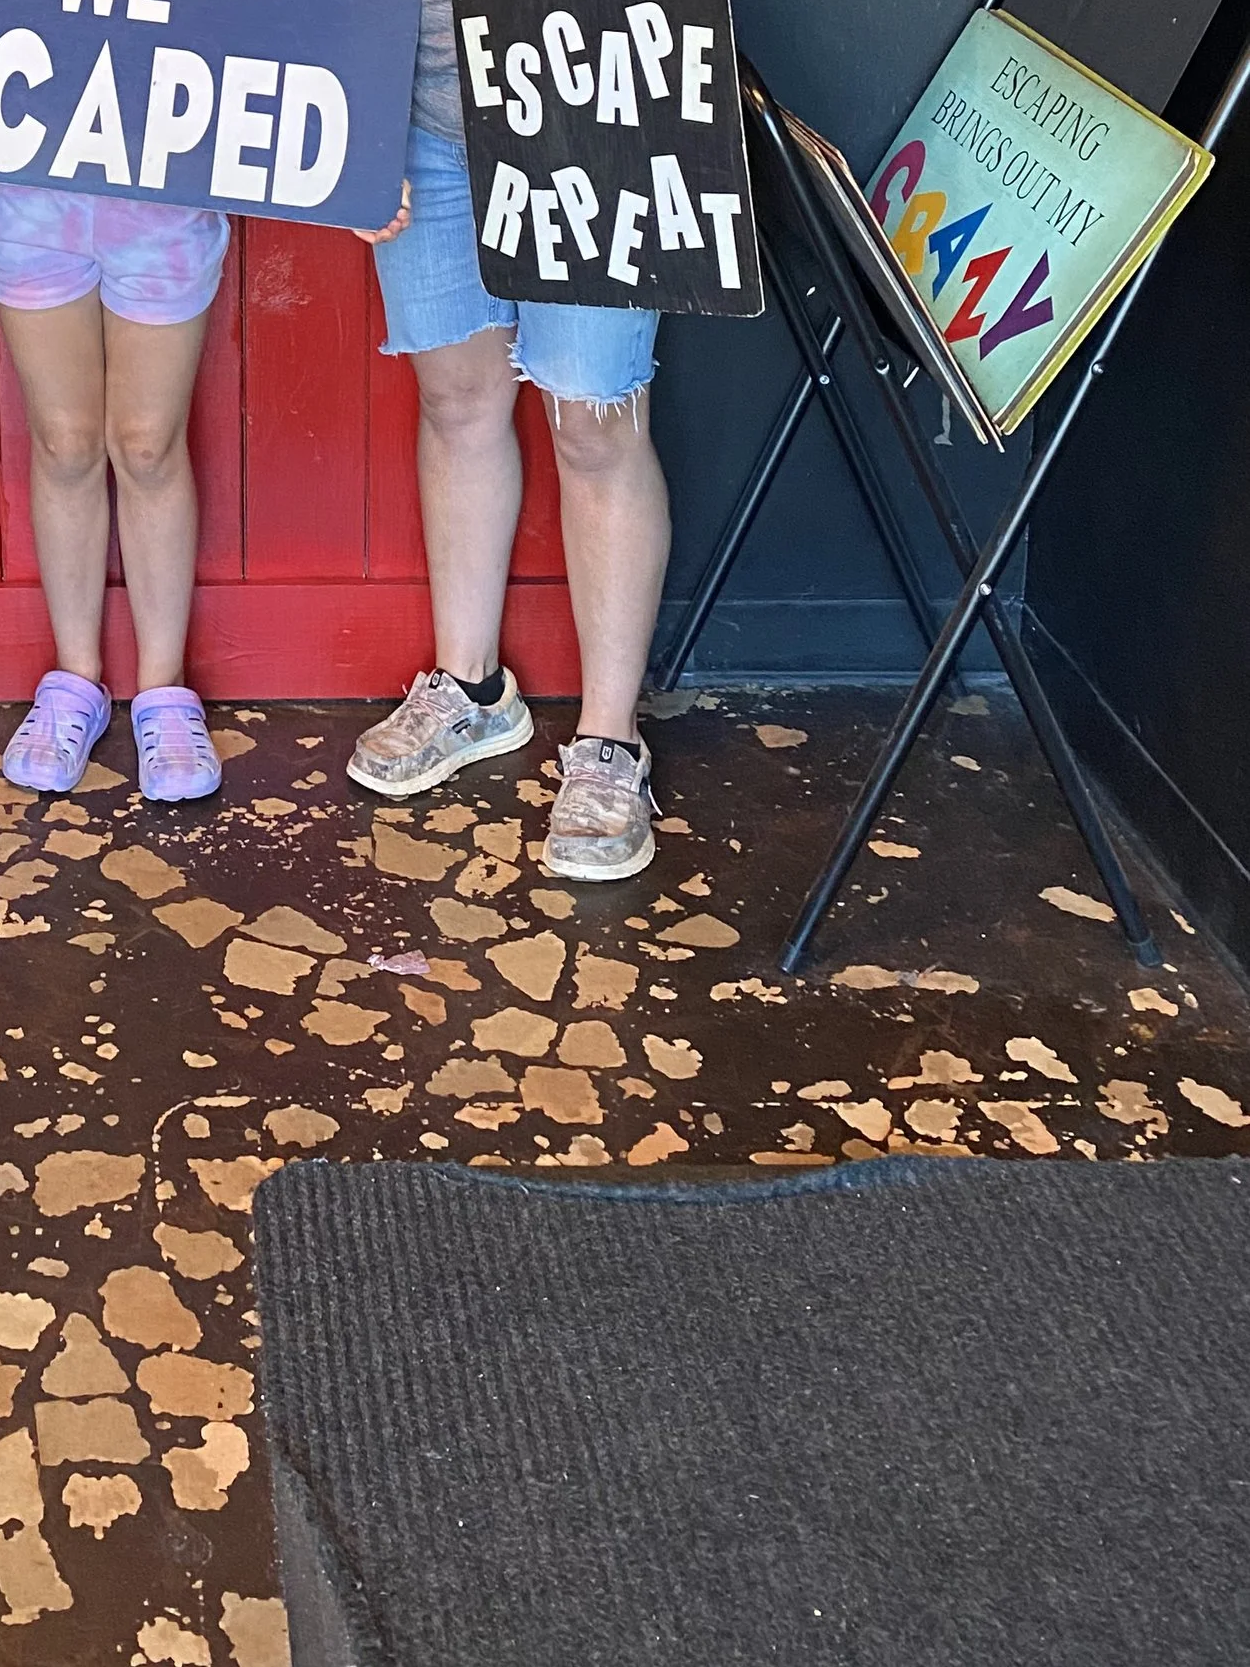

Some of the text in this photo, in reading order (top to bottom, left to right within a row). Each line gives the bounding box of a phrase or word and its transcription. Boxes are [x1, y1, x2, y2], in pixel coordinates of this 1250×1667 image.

[461, 1, 714, 136] ESCAPE
[990, 56, 1111, 162] ESCAPING
[480, 154, 742, 289] REPEAT
[930, 90, 1105, 248] BRINGS OUT MY
[868, 139, 1055, 362] CRAZY
